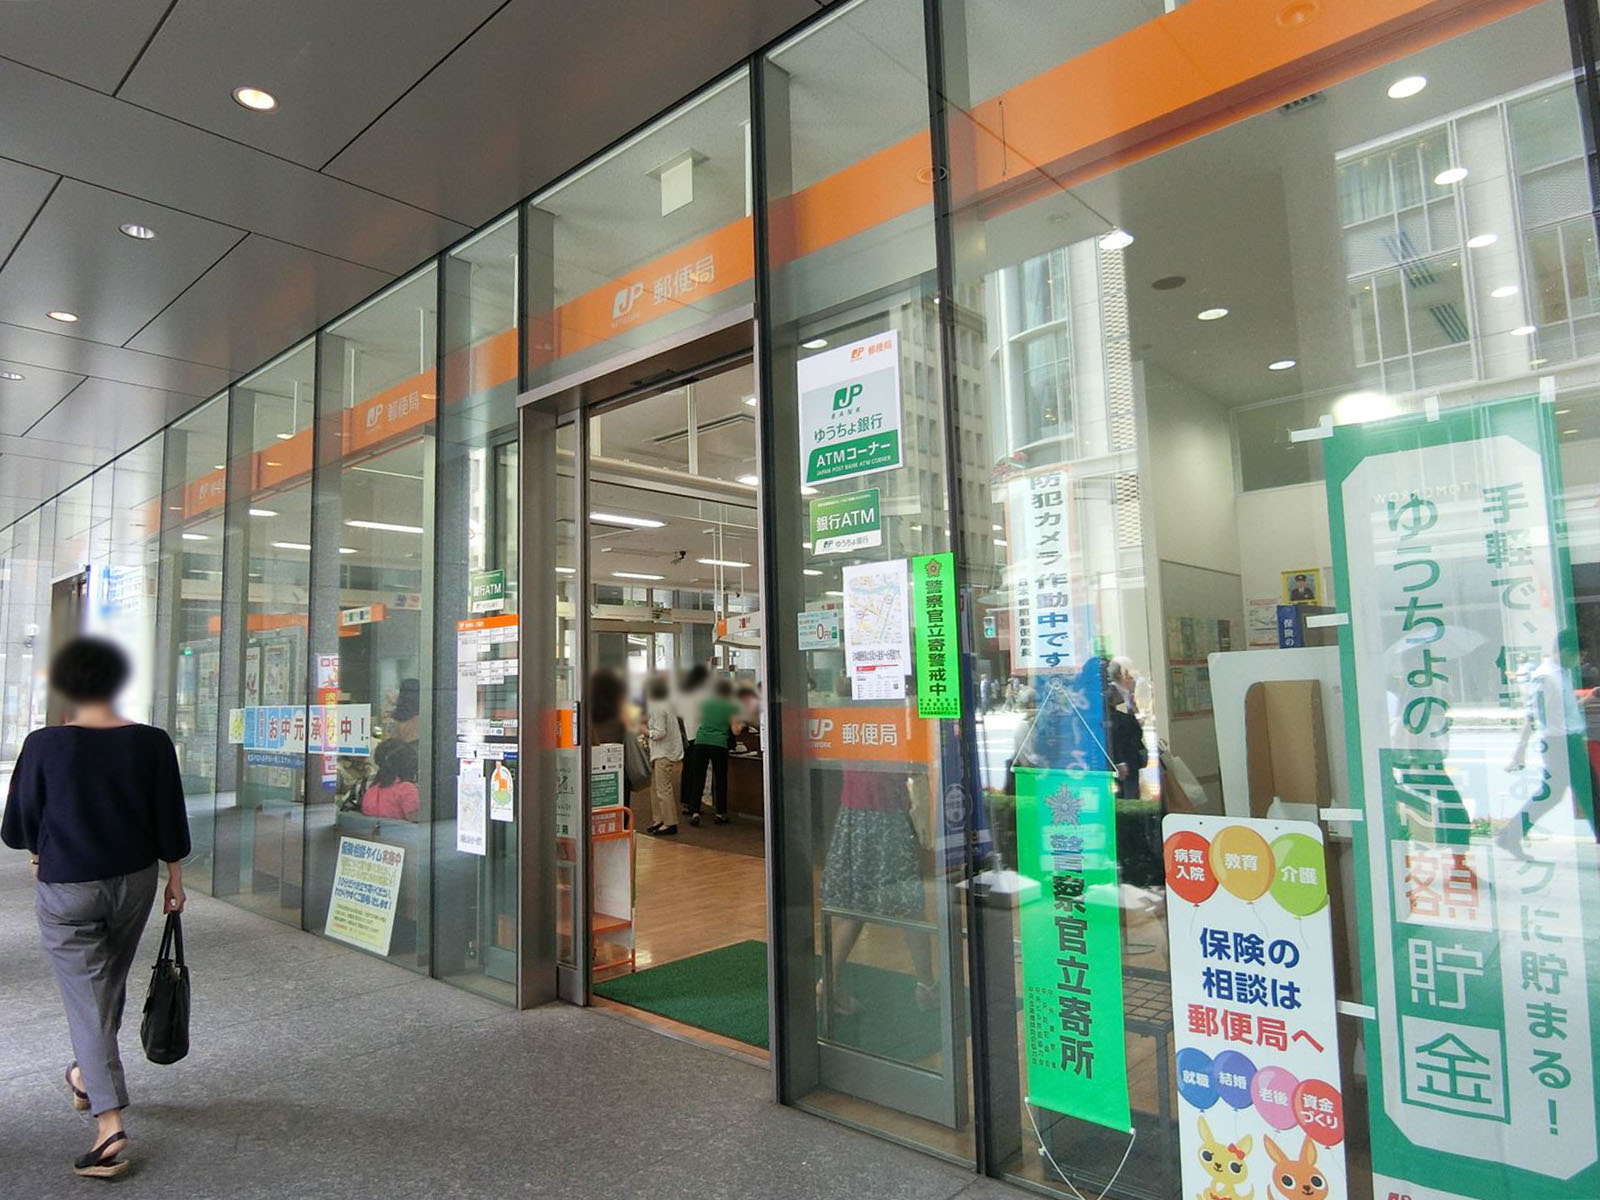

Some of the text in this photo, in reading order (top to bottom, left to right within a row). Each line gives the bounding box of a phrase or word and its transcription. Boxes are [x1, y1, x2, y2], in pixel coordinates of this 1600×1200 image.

[612, 253, 715, 320] JP 郵便局
[832, 384, 863, 410] JP
[814, 412, 882, 443] ゆうちょ銀行
[816, 441, 891, 468] ATMコーナー
[816, 508, 875, 532] 銀行ATM
[1030, 472, 1070, 668] 防犯カメラ作動中です
[925, 579, 947, 697] 警察官立寄警戒中
[841, 723, 898, 745] 郵便局
[1174, 848, 1204, 865] 病気
[1224, 852, 1258, 872] 教育
[1175, 865, 1205, 882] 入院
[1281, 865, 1319, 885] 介護
[1049, 832, 1095, 1080] 警察官立寄所
[1199, 927, 1300, 969] 保険の
[1202, 967, 1301, 1010] 相談は
[1187, 1004, 1324, 1053] 郵便局へ
[1182, 1069, 1209, 1088] 就職
[1219, 1071, 1247, 1090] 結婚
[1258, 1087, 1288, 1106] 老後
[1302, 1094, 1334, 1113] 資金
[1300, 1109, 1338, 1128] づくり
